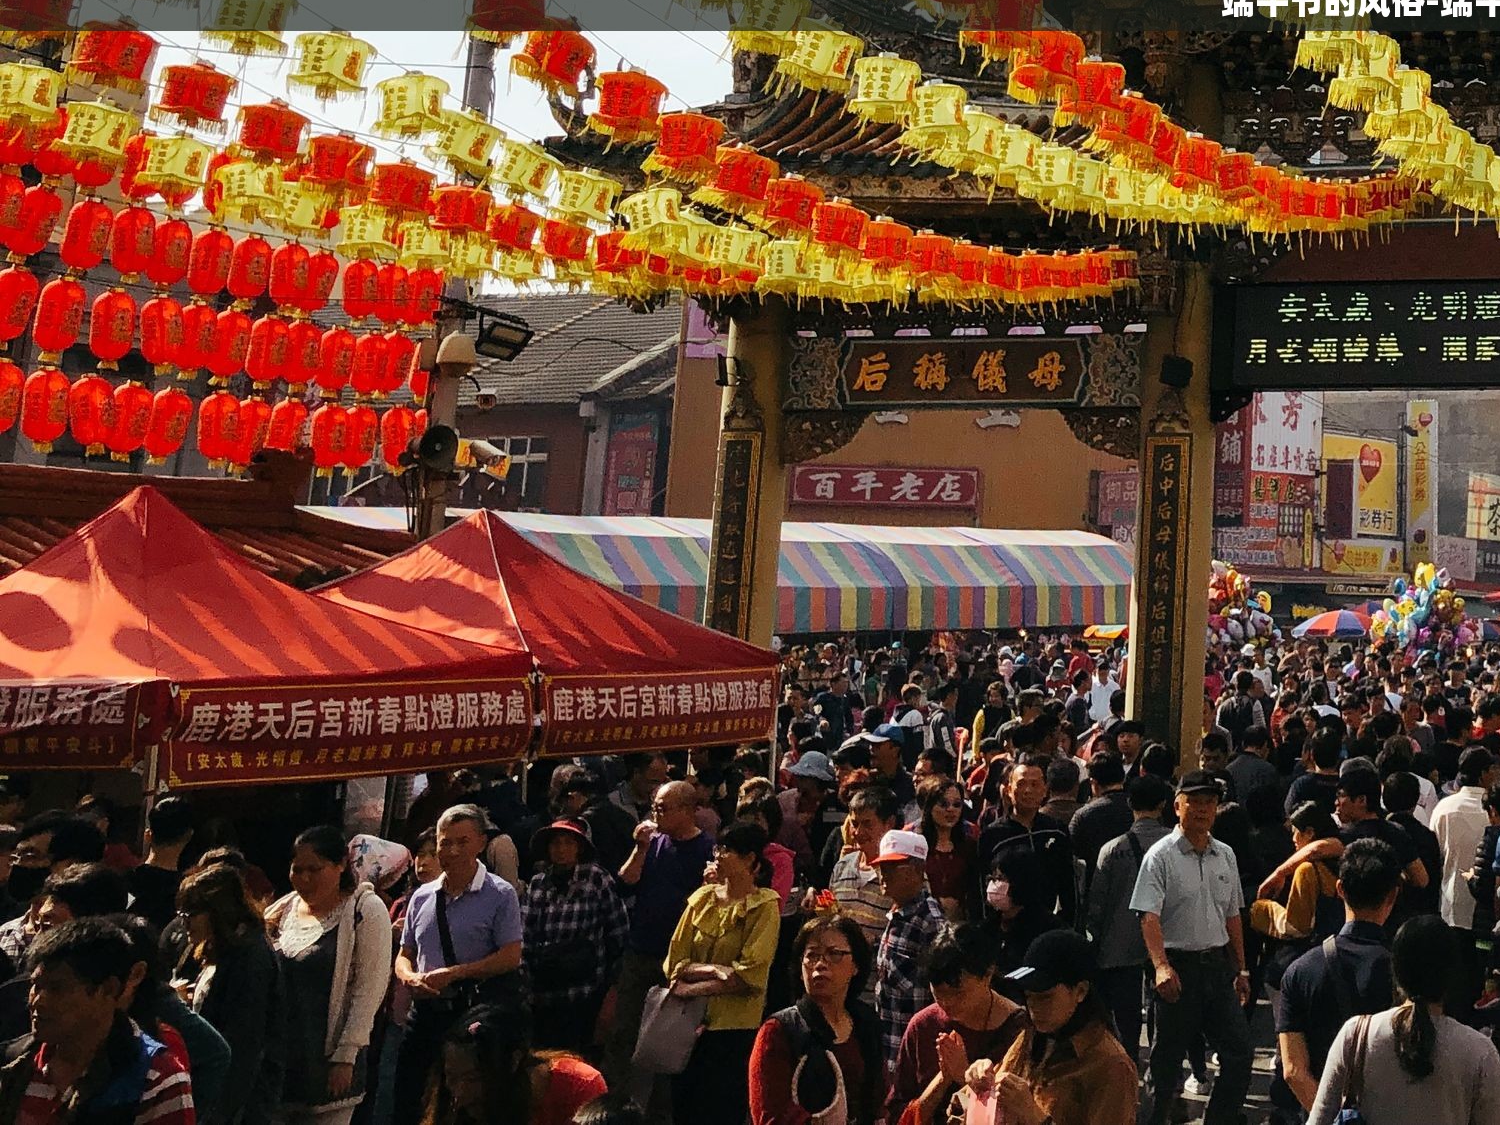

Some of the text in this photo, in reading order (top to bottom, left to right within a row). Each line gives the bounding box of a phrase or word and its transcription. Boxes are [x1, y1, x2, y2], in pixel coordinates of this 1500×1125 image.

[807, 472, 962, 503] 百年老店
[1359, 508, 1394, 531] 彩券行
[181, 689, 526, 743] 鹿港天后宮新春點燈服務處
[552, 678, 772, 722] 鹿港天后宮新春點燈服務處
